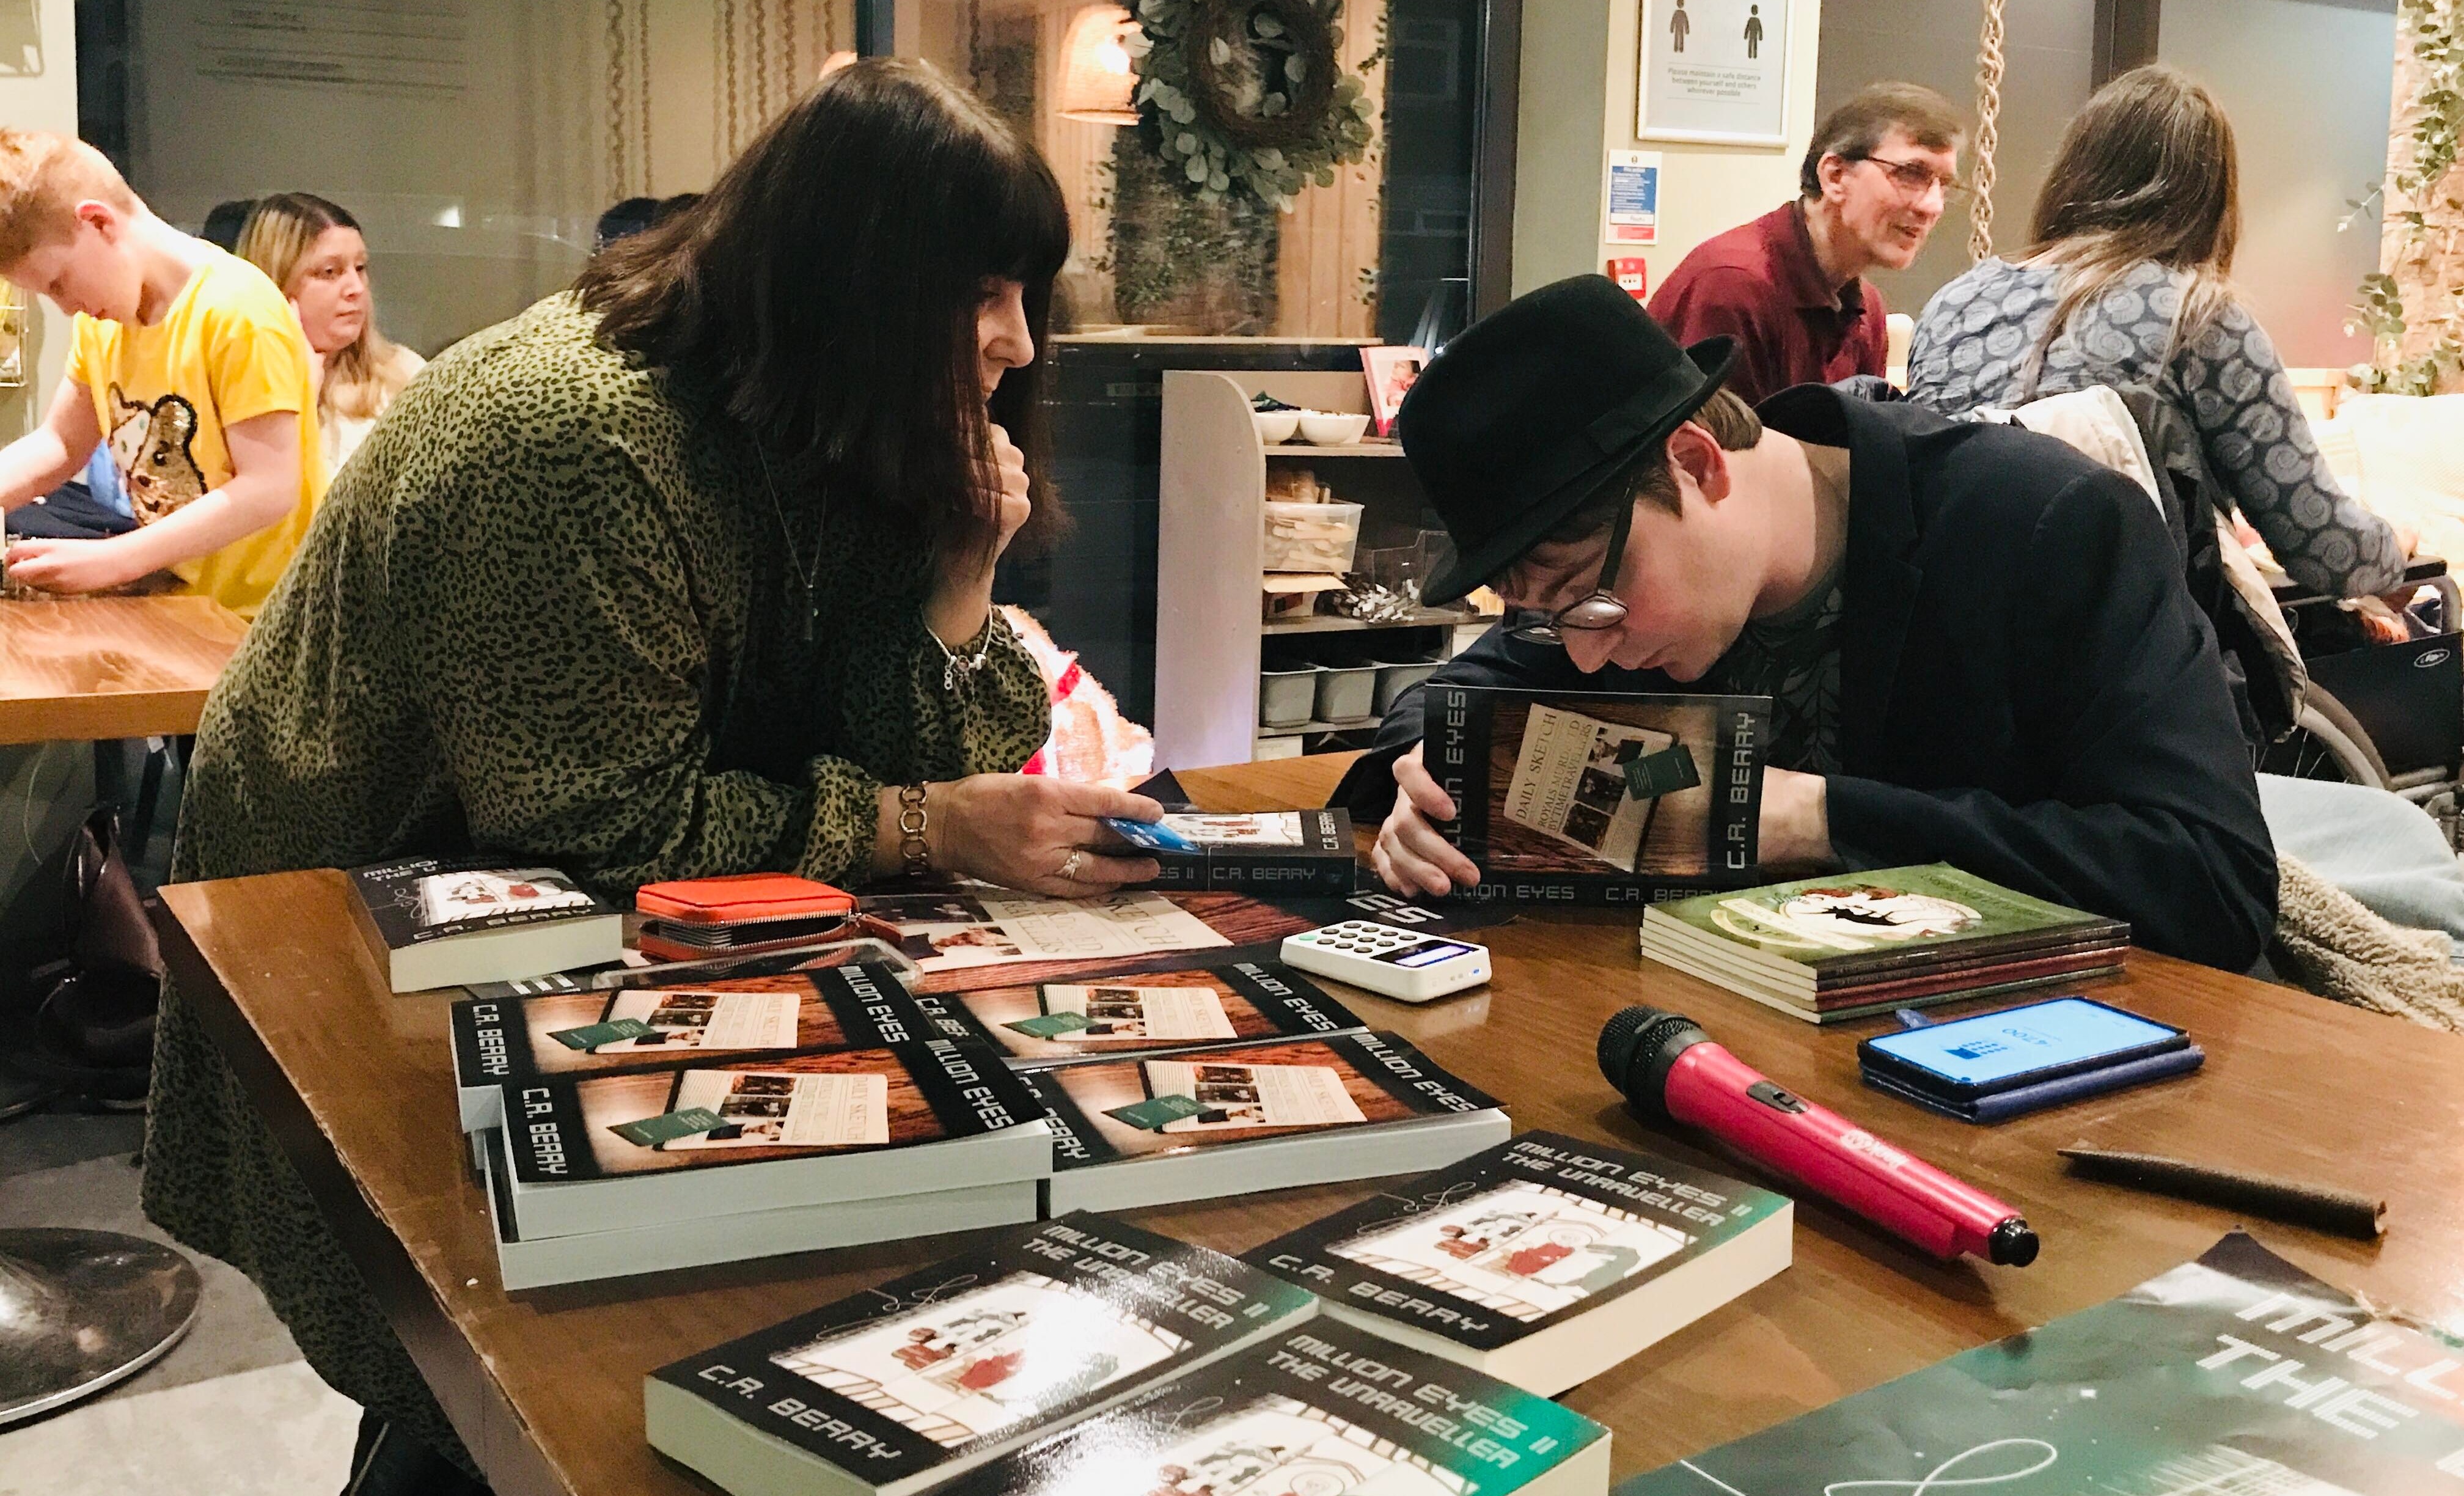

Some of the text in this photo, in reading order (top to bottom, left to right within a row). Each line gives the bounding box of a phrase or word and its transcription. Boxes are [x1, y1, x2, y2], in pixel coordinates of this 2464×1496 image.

[1716, 89, 1741, 97] possible
[1736, 73, 1761, 81] distance
[1446, 691, 1467, 765] EYES
[1516, 713, 1557, 820] DAILY SKETCH
[1727, 712, 1757, 870] C.R. BERRY
[1318, 812, 1336, 835] BERRY
[1538, 788, 1557, 827] ROYALS
[1548, 817, 1558, 831] BY
[1553, 791, 1569, 817] TIME
[363, 860, 438, 878] MILLIO
[1213, 868, 1245, 880] C.R.
[1253, 868, 1316, 880] BERRY
[1516, 884, 1575, 900] EYES
[1606, 888, 1645, 901] C.R.
[837, 965, 911, 1044] MILLION EYES
[1232, 963, 1338, 1031] MILLION EYES
[472, 1003, 510, 1076] C.R. BERRY
[1350, 1033, 1480, 1112] MILLION EYES
[925, 1039, 980, 1085] MILLION
[963, 1086, 1015, 1129] EYES
[522, 1088, 568, 1175] C.R. BERRY
[1502, 1151, 1726, 1227] THE UNRAVELLER
[1513, 1141, 1625, 1176] MILLION
[1627, 1170, 1728, 1208] EYES
[1022, 1238, 1077, 1261] THE
[1042, 1225, 1150, 1266] MILLION
[1146, 1261, 1246, 1307] EYES
[1268, 1253, 1491, 1332] C.R. BERRY
[697, 1364, 903, 1459] C.R. BERRY
[1266, 1349, 1521, 1470] THE UNRAVELLER
[1286, 1334, 1414, 1390] MILLION
[1412, 1382, 1530, 1440] EYES
[2195, 1333, 2421, 1440] THE
